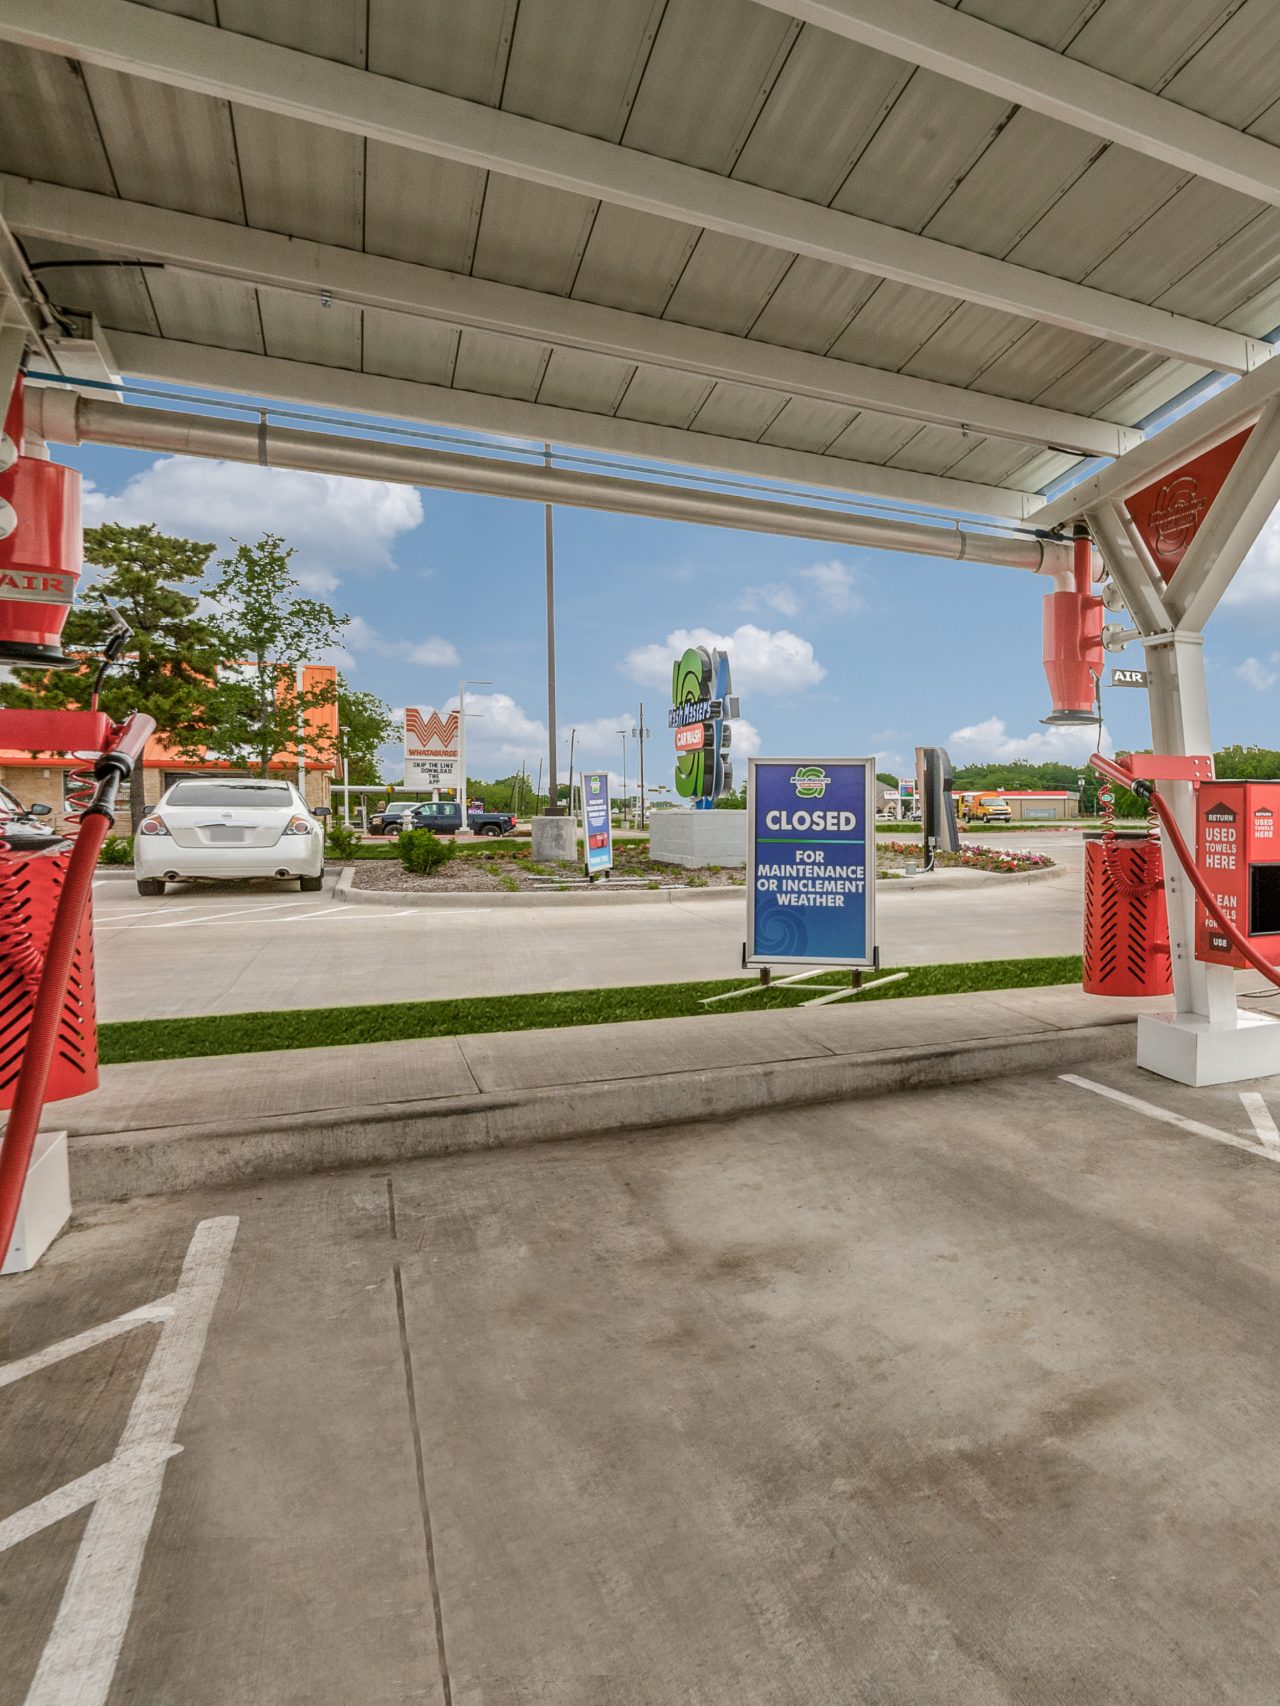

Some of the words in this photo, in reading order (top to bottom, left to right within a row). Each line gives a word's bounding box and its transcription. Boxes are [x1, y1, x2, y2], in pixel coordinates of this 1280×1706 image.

[0, 574, 65, 593] AIR
[1113, 670, 1144, 683] AIR
[408, 749, 459, 757] WHATABURGE
[765, 810, 857, 831] CLOSED
[1208, 814, 1234, 822] RETURN
[1254, 818, 1274, 826] USED
[1205, 827, 1237, 842] USED
[1205, 842, 1237, 854] TOWELS
[795, 850, 825, 863] FOR
[1205, 854, 1236, 870] HERE
[757, 864, 865, 879] MAINTENANCE
[756, 879, 778, 891] OR
[782, 879, 865, 893] INCLEMENT
[776, 893, 845, 907] WEATHER
[1211, 893, 1237, 908] EAN
[1213, 937, 1228, 947] USE
